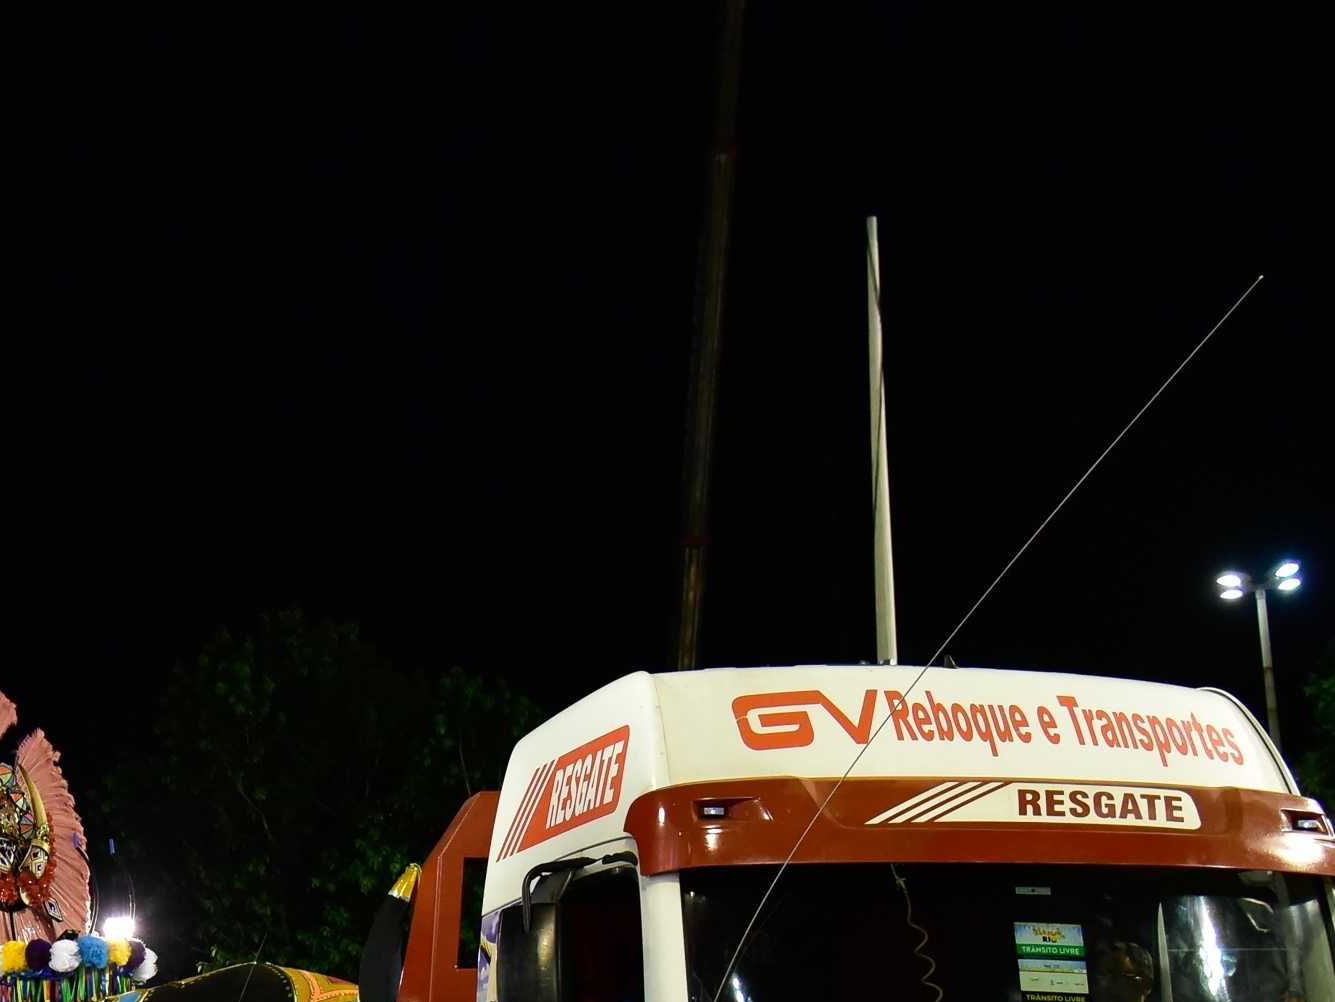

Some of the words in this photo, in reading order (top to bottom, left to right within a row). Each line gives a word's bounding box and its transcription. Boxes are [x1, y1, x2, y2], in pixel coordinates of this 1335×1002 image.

[731, 689, 878, 750] GV
[884, 690, 1032, 757] Reboque
[1037, 705, 1061, 744] e
[1056, 695, 1244, 767] Transportes
[546, 739, 625, 829] RESGATE
[1017, 789, 1185, 823] RESGATE
[1022, 945, 1057, 954] TRÂNSITO
[1060, 947, 1080, 955] LIVRE
[1026, 993, 1063, 1002] TRÂNSITO
[1065, 995, 1086, 1002] LIVRE
